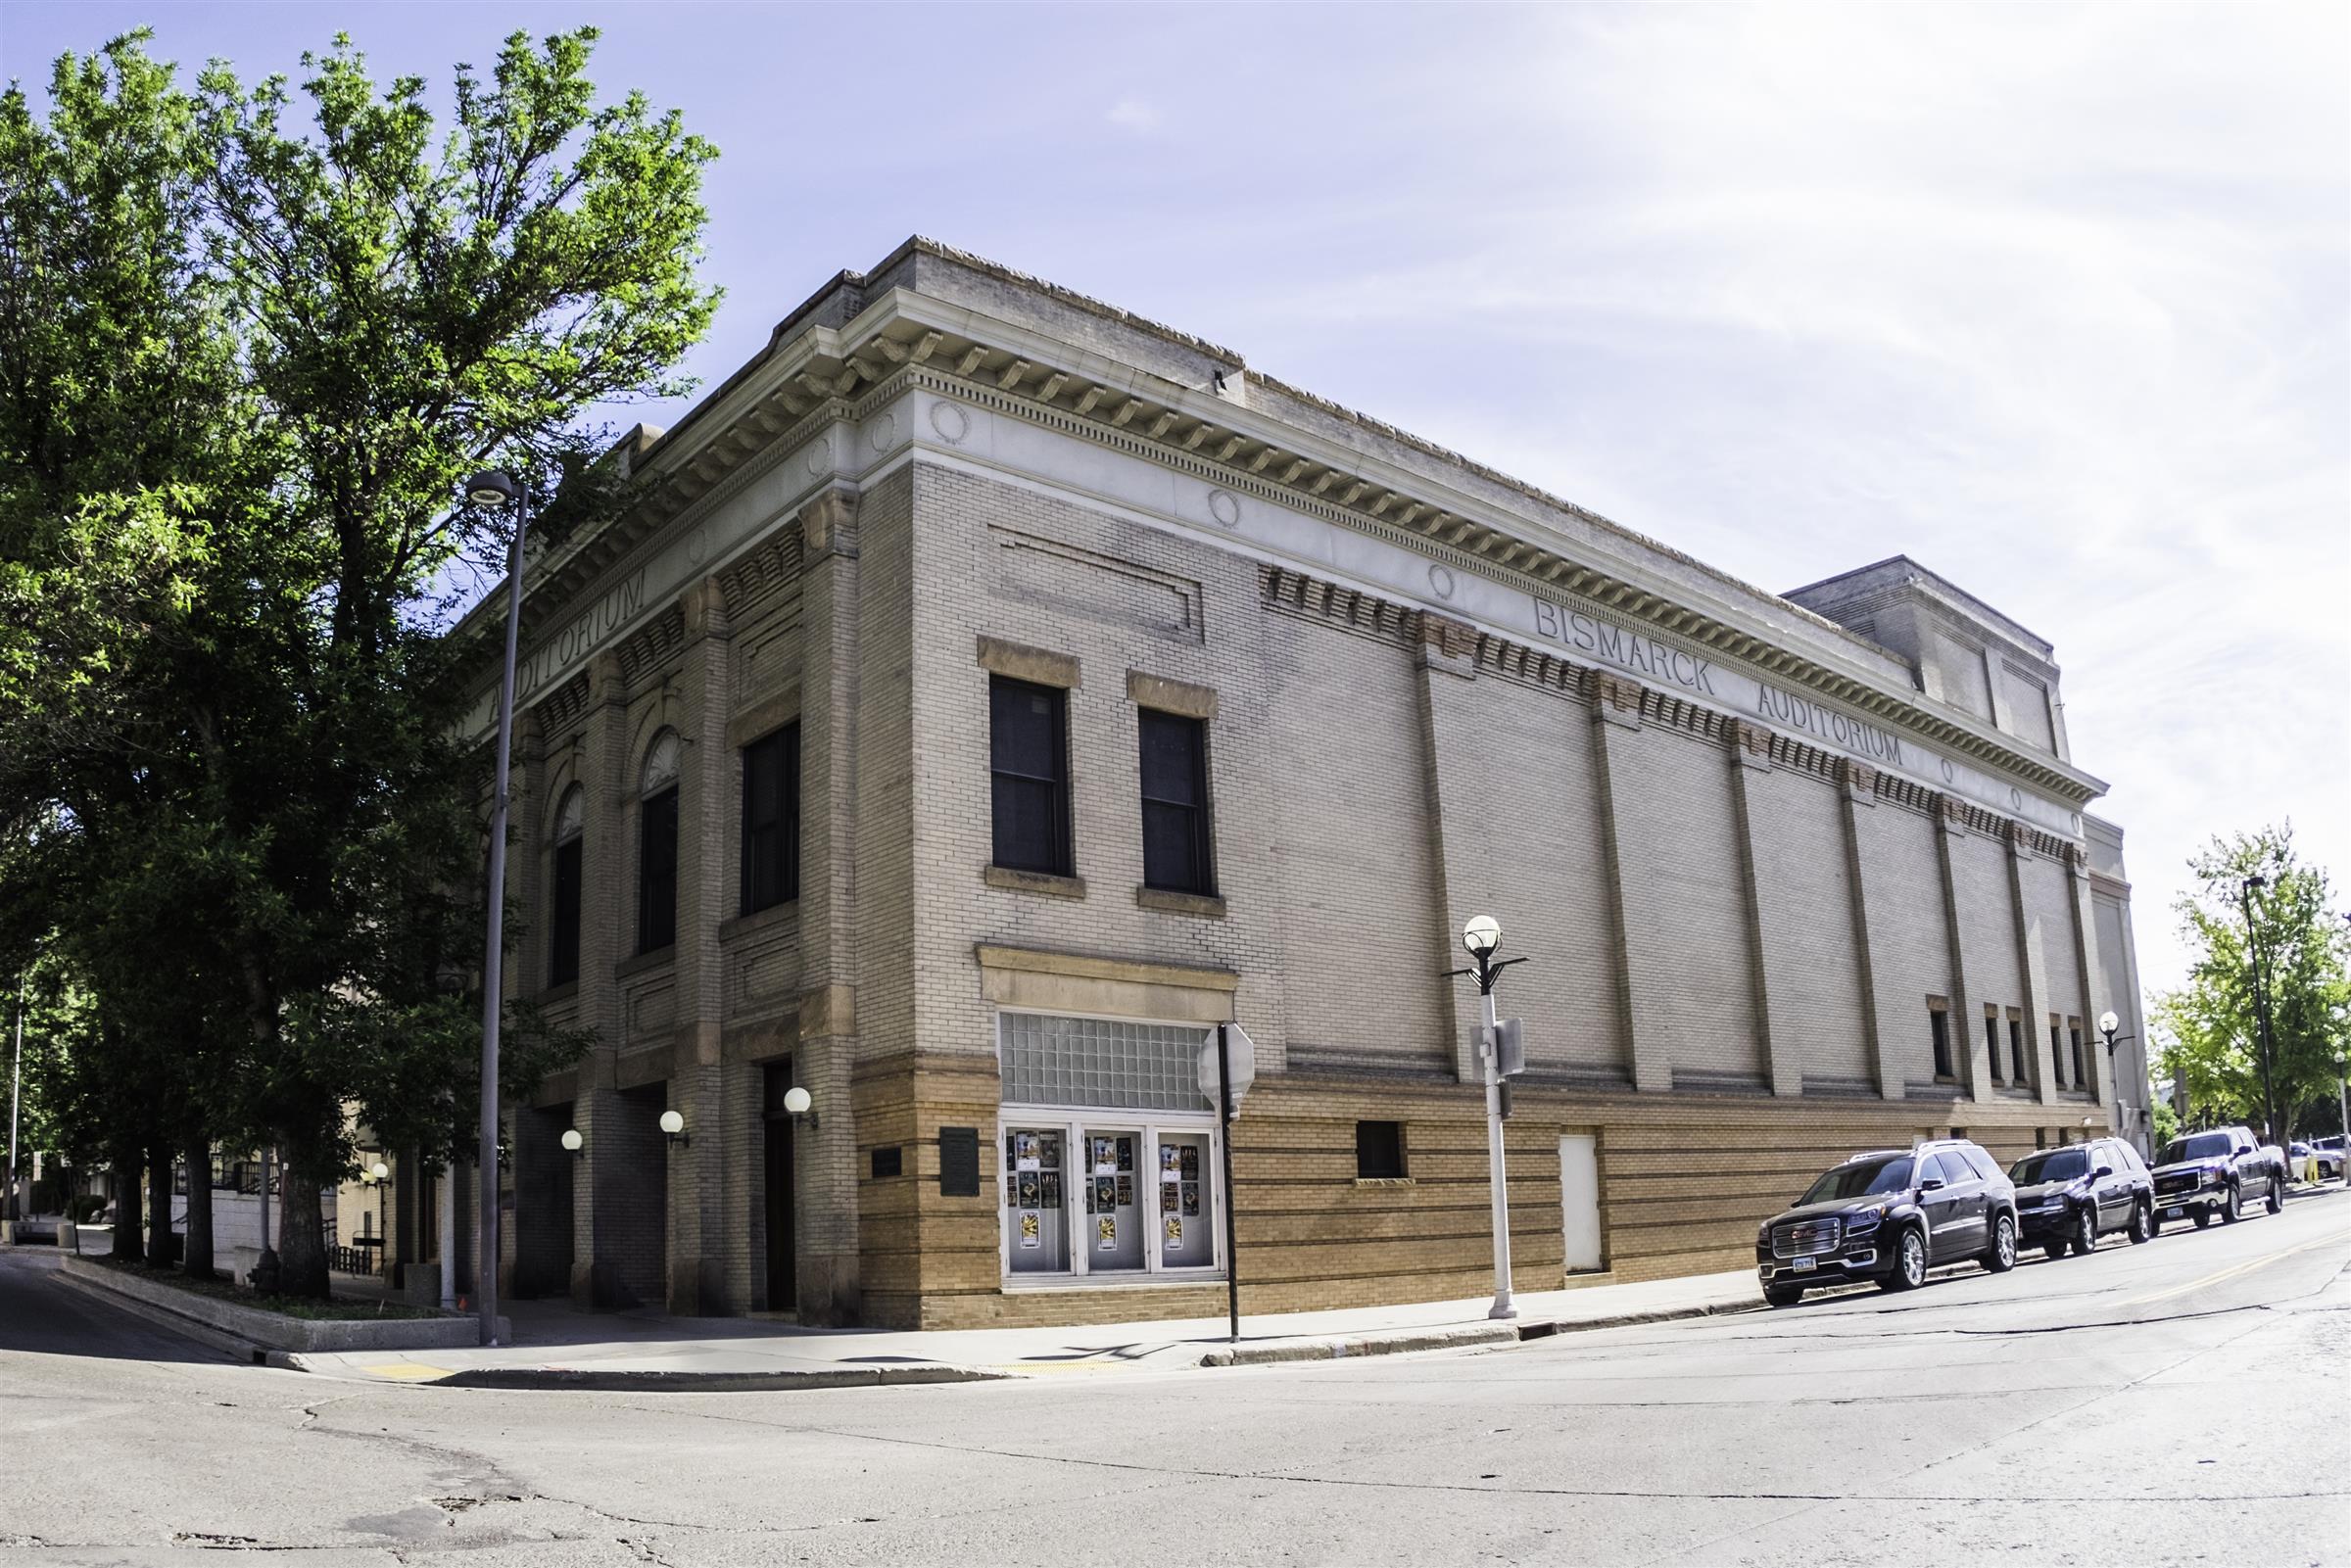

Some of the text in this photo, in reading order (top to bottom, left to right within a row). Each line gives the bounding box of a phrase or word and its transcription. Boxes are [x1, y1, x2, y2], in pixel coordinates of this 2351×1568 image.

[489, 568, 645, 723] ADITORIUM
[1533, 597, 1903, 765] BISMARCK AUDITORIUM
[1792, 1228, 1818, 1239] GMC
